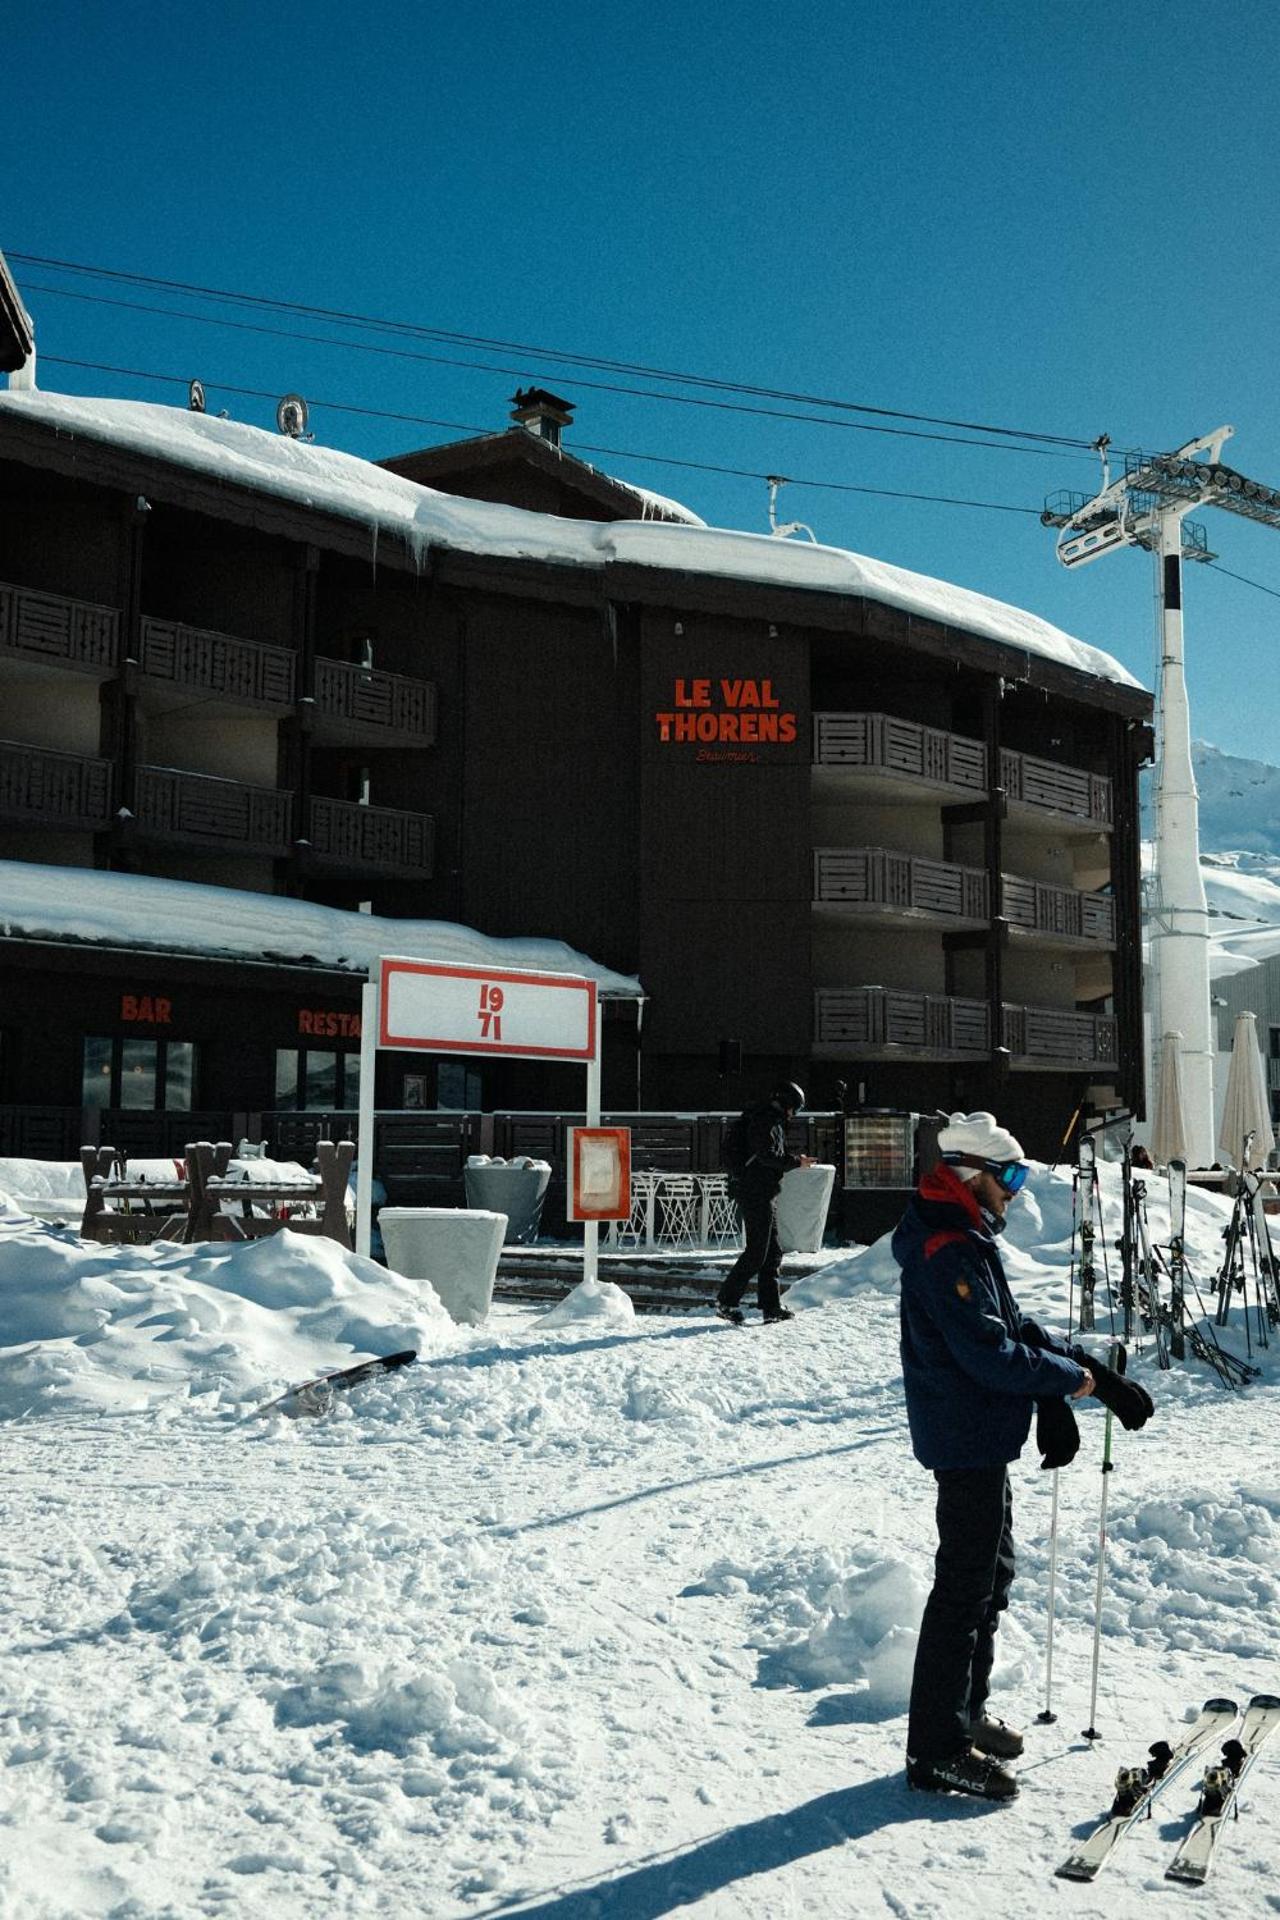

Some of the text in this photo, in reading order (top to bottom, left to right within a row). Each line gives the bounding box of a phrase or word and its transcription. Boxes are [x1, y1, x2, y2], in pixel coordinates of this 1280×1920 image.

[675, 679, 779, 707] LE VAL
[656, 713, 797, 742] THORENS
[121, 995, 172, 1024] BAR
[479, 984, 504, 1012] 19
[477, 1012, 502, 1040] 71
